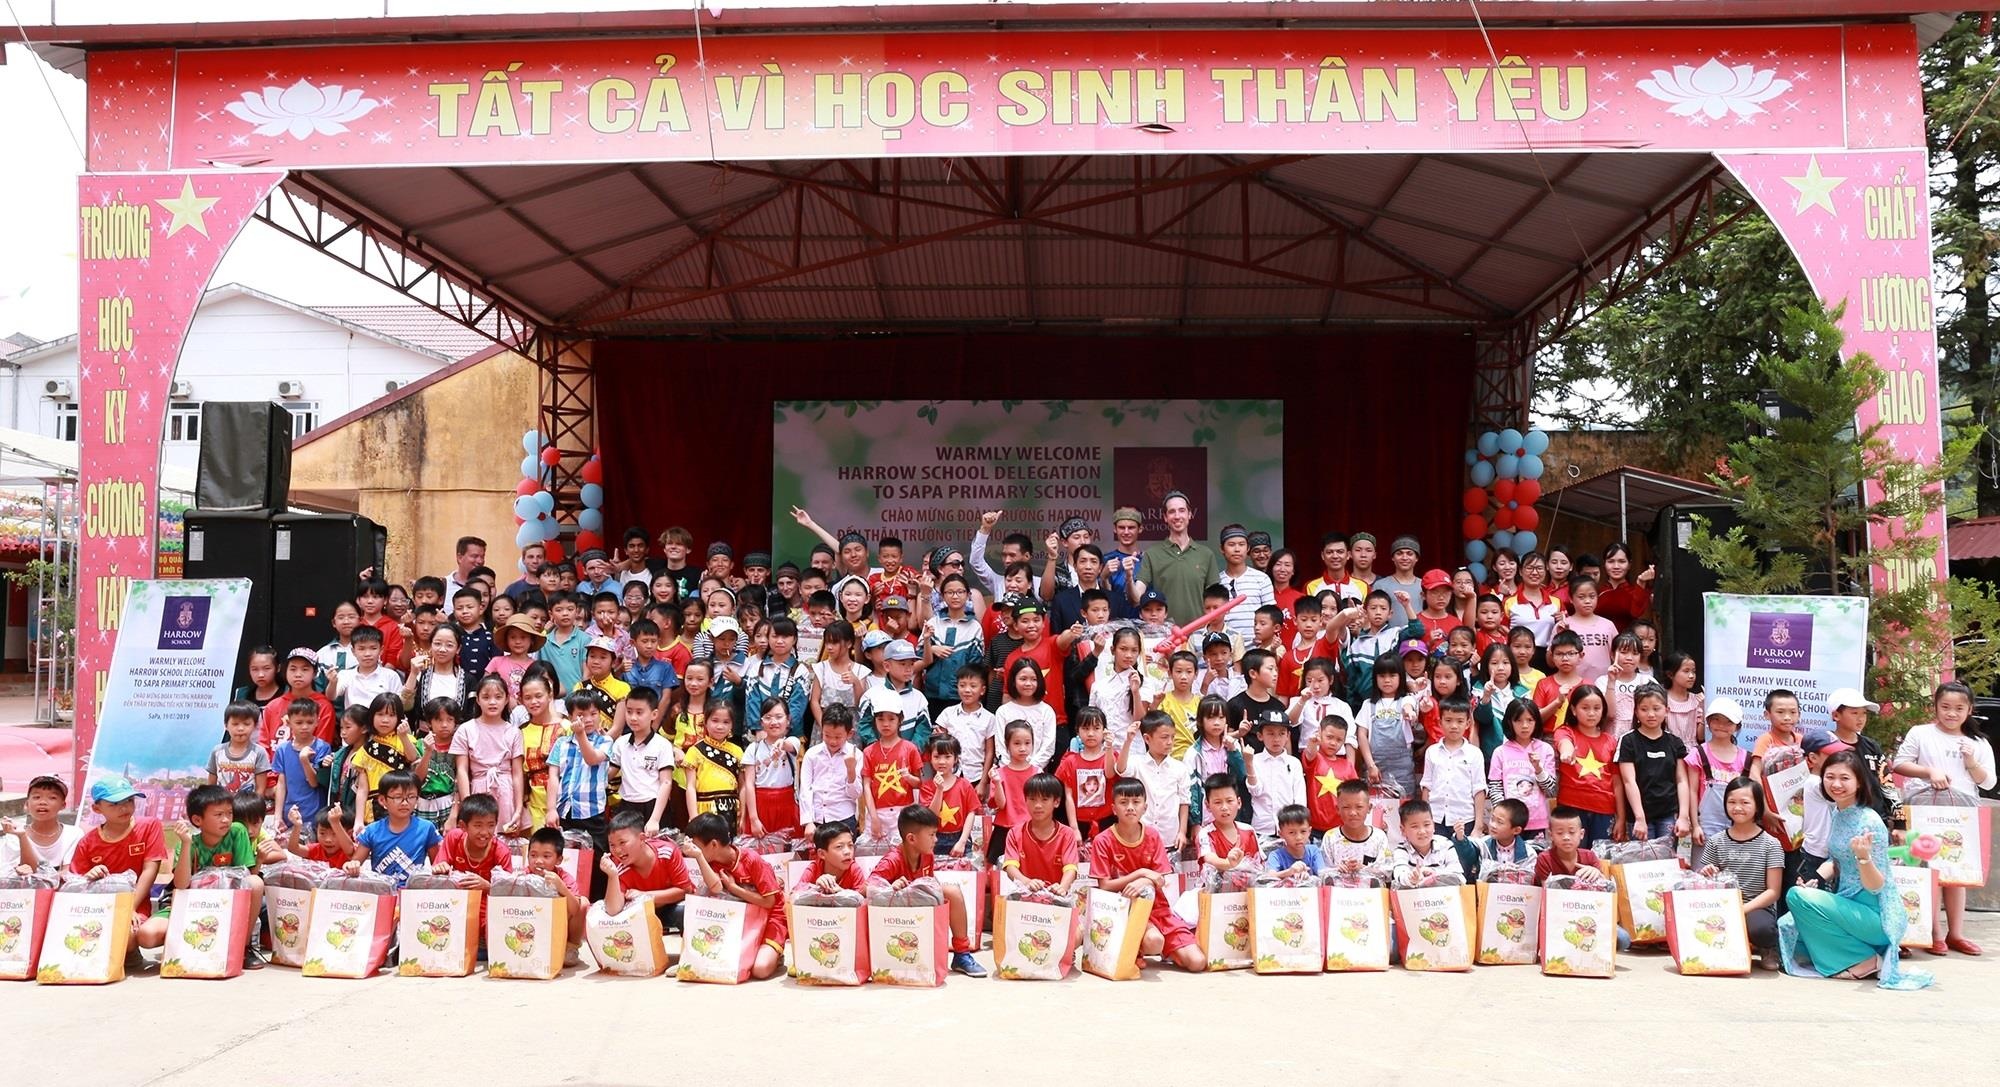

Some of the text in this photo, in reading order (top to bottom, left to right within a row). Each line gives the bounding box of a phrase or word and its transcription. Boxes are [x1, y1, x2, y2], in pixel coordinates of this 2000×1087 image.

[428, 54, 1589, 140] TẤT CẢ VÌ HỌC SINH THÂN YÊU
[1864, 166, 1917, 240] CHẤT
[81, 191, 150, 260] TRƯỜNG
[1861, 272, 1931, 345] LƯỢNG
[98, 296, 134, 364] HỌC
[1877, 358, 1926, 425] GIÁO
[105, 366, 128, 444] KỶ
[936, 446, 1101, 460] WARMLY WELCOME
[838, 466, 1101, 480] HARROW SCHOOL DELEGATION
[873, 485, 1102, 499] TO SAPA PRIMARY SCHOOL
[86, 478, 145, 538] CƯƠNG
[958, 507, 988, 522] ĐOÀ
[163, 630, 202, 638] HARROW
[1753, 647, 1805, 658] HARROW
[149, 657, 206, 665] WARMLY WELCOME
[129, 668, 225, 677] HARROW SCHOOL DELEGATION
[134, 679, 216, 688] TO SAPA PRIMARY SCHOOL
[1738, 675, 1817, 688] WARMLY WELCOME
[1716, 686, 1752, 696] HARROW
[1794, 690, 1831, 700] ELEGATI
[1735, 699, 1755, 709] APA
[1927, 815, 1961, 824] HDBank
[1269, 899, 1301, 907] HDBank
[1413, 900, 1445, 908] HDBank
[1497, 895, 1525, 903] HDBank
[70, 905, 105, 914] HDBank
[188, 901, 220, 909] HDBank
[330, 902, 362, 912] HDBank
[416, 900, 450, 910] HDBank
[1223, 904, 1249, 912] HDBank
[1562, 901, 1596, 911] HDBank
[1689, 901, 1722, 909] HDBank
[502, 907, 534, 916] HDBank
[695, 908, 727, 919] HDBank
[807, 918, 838, 926] HDBank
[883, 917, 916, 926] HDBank
[1020, 914, 1052, 925] HDBank
